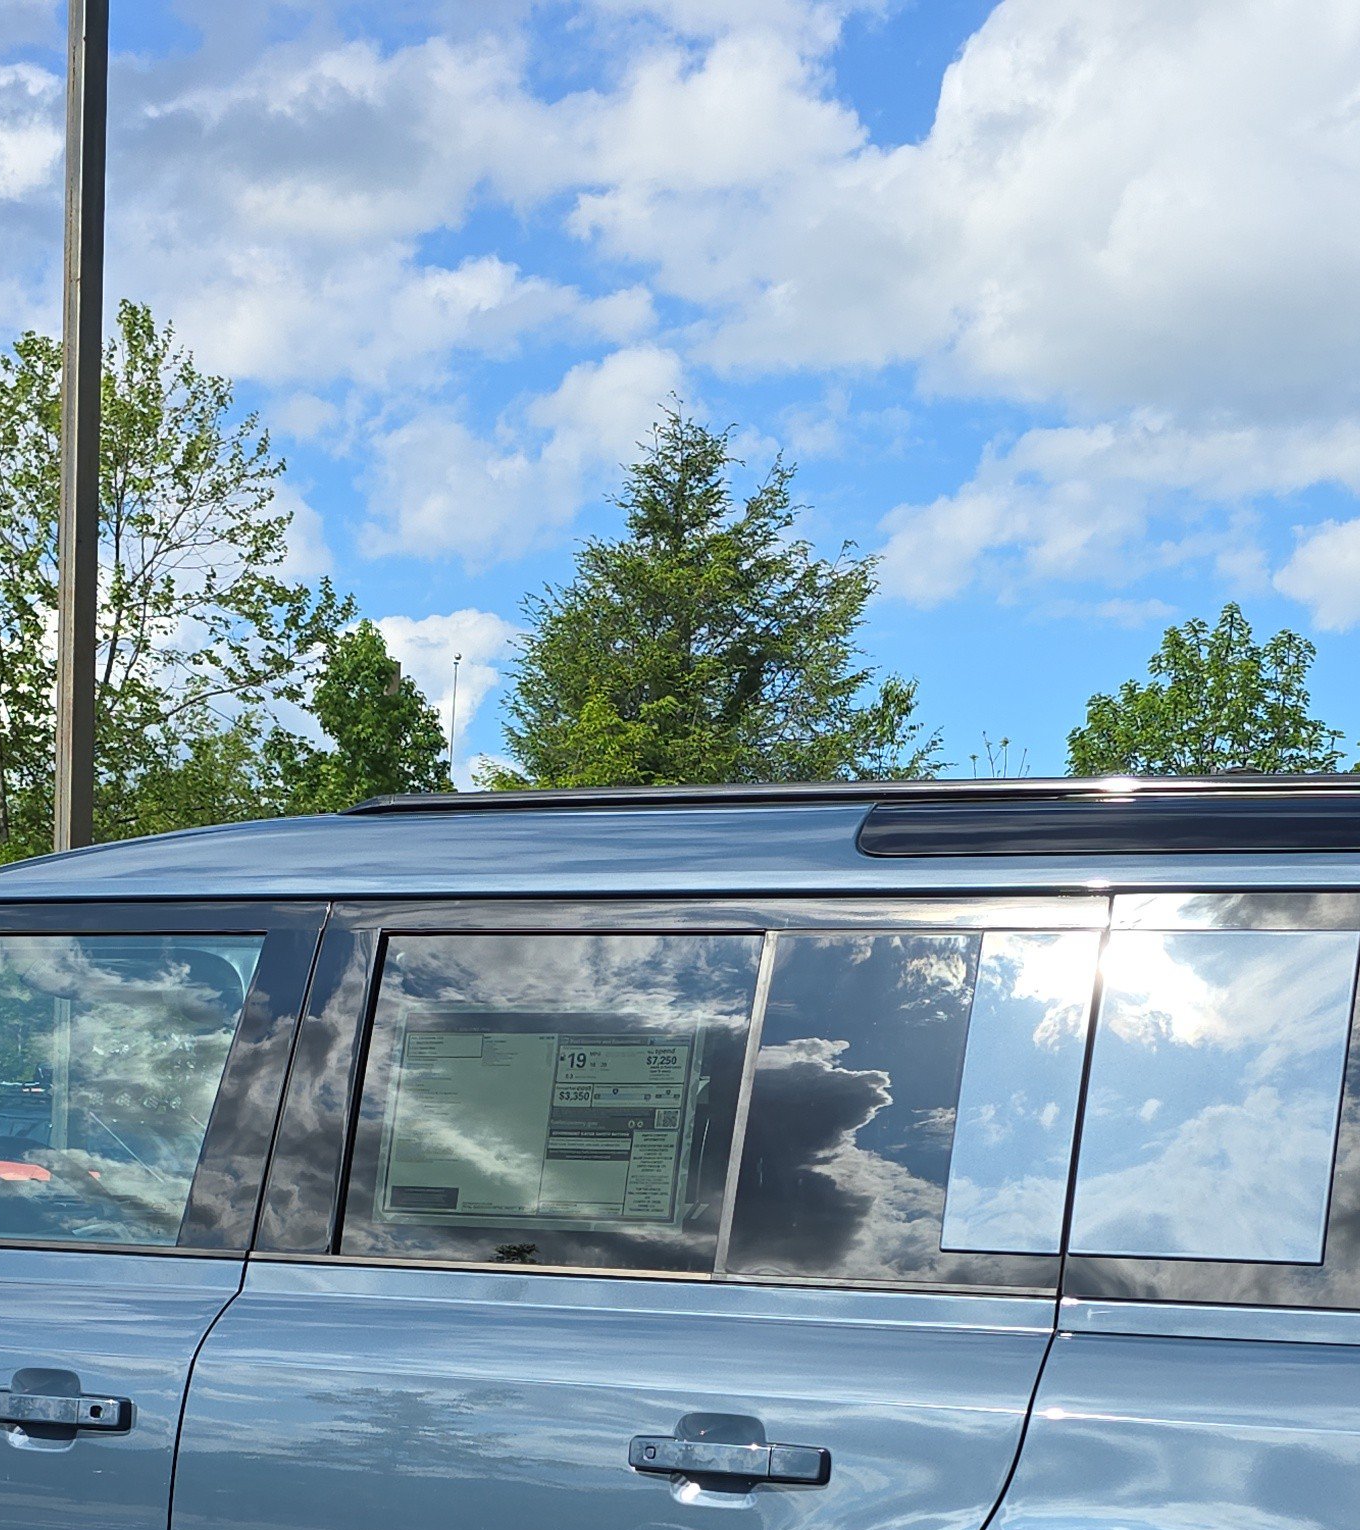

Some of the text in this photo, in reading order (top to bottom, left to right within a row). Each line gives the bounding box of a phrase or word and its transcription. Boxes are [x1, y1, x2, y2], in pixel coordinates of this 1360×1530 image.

[567, 1052, 586, 1068] 19
[646, 1056, 677, 1067] $7,250
[559, 1091, 590, 1101] $3,350
